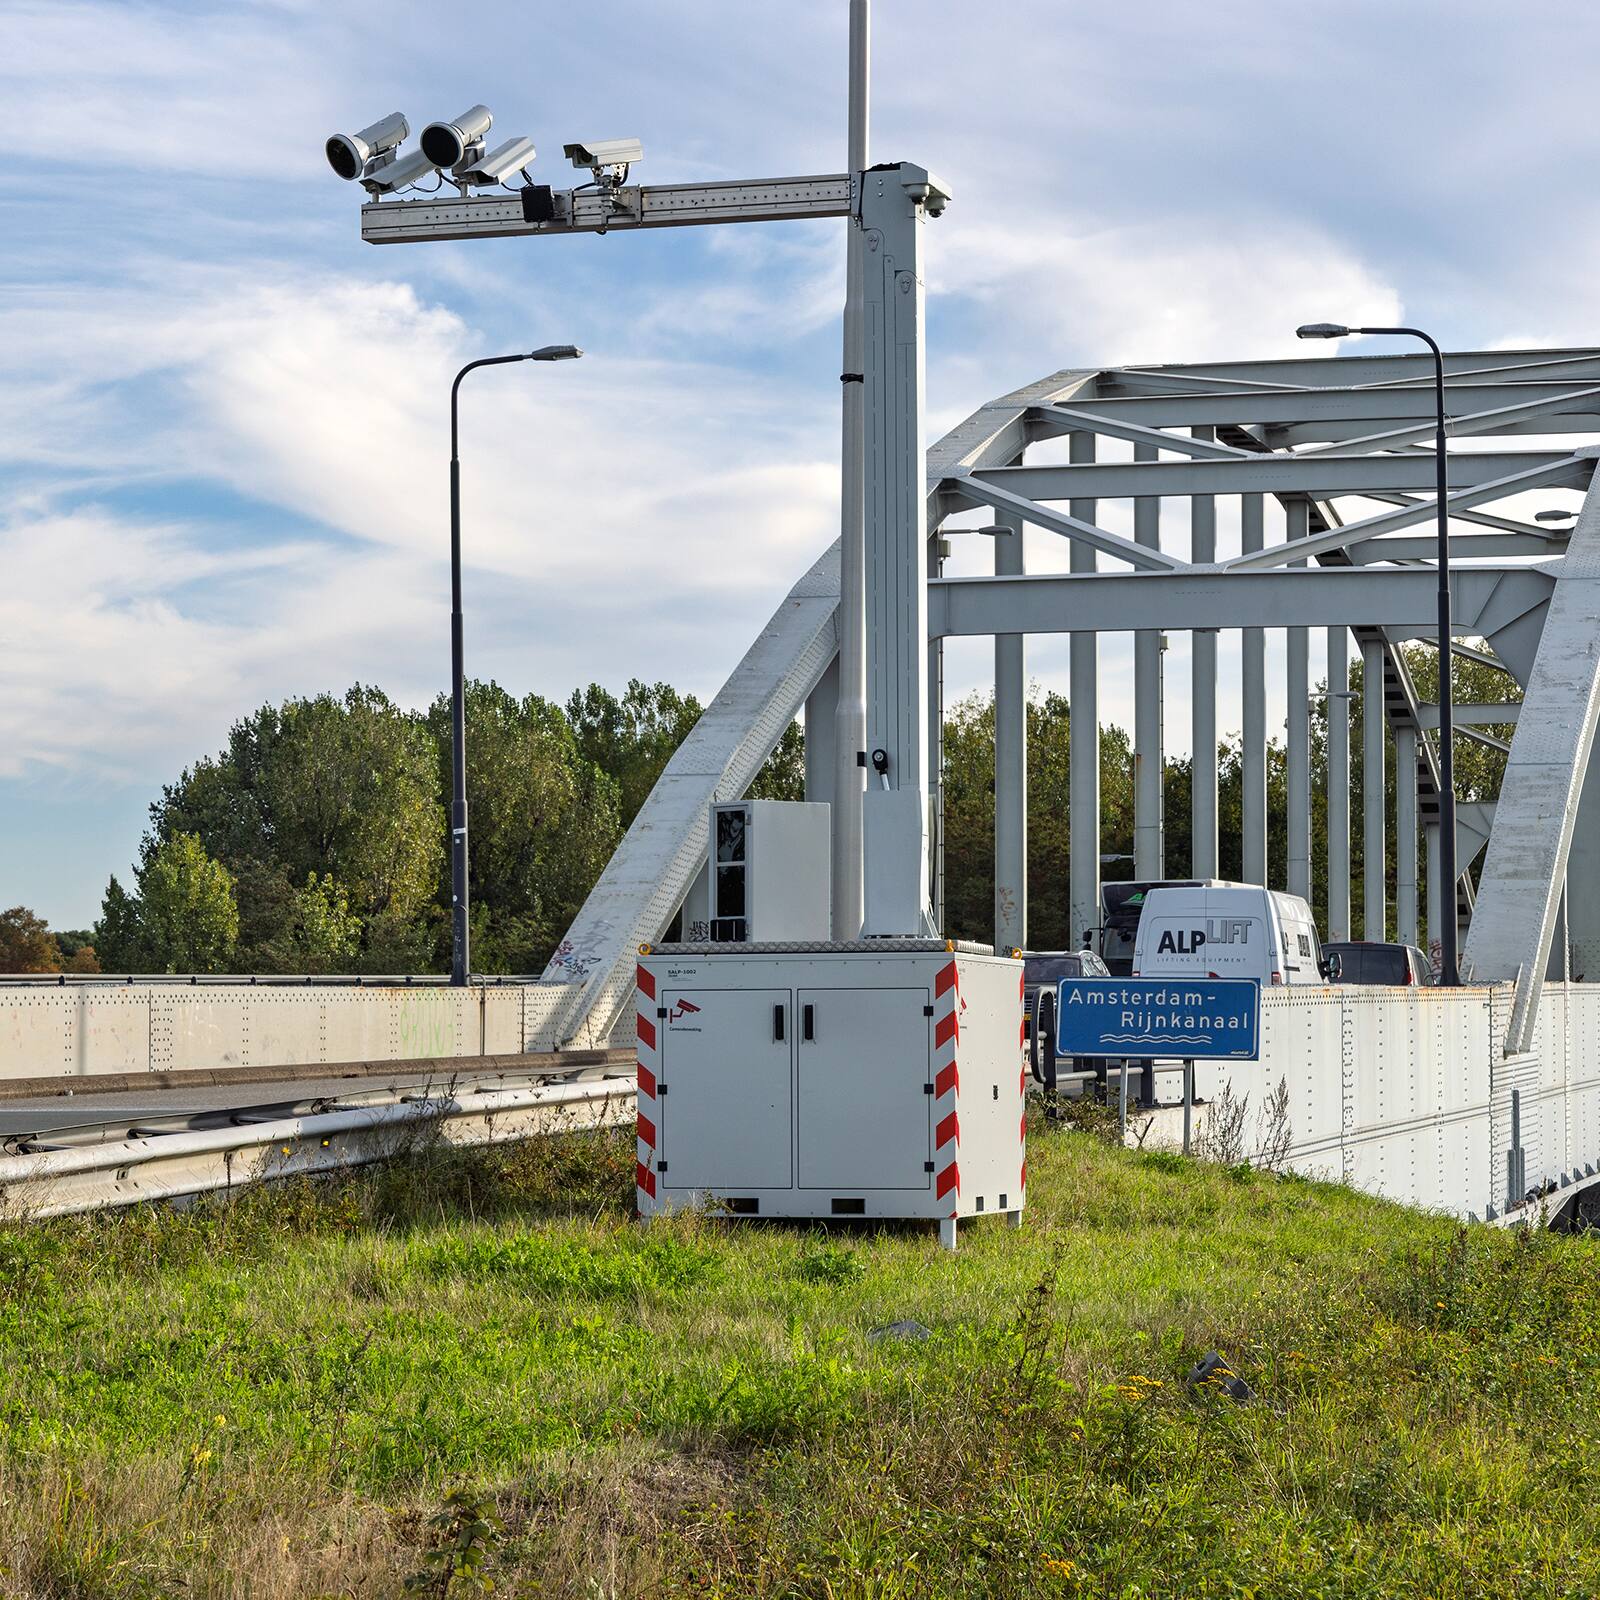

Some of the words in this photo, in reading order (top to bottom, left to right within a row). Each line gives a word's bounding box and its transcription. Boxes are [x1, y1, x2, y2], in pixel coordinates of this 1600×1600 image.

[1157, 930, 1206, 954] ALP
[1206, 919, 1252, 944] LIFT
[1068, 987, 1216, 1006] Amsterdam-
[1120, 1011, 1248, 1033] Rijnkanaal
